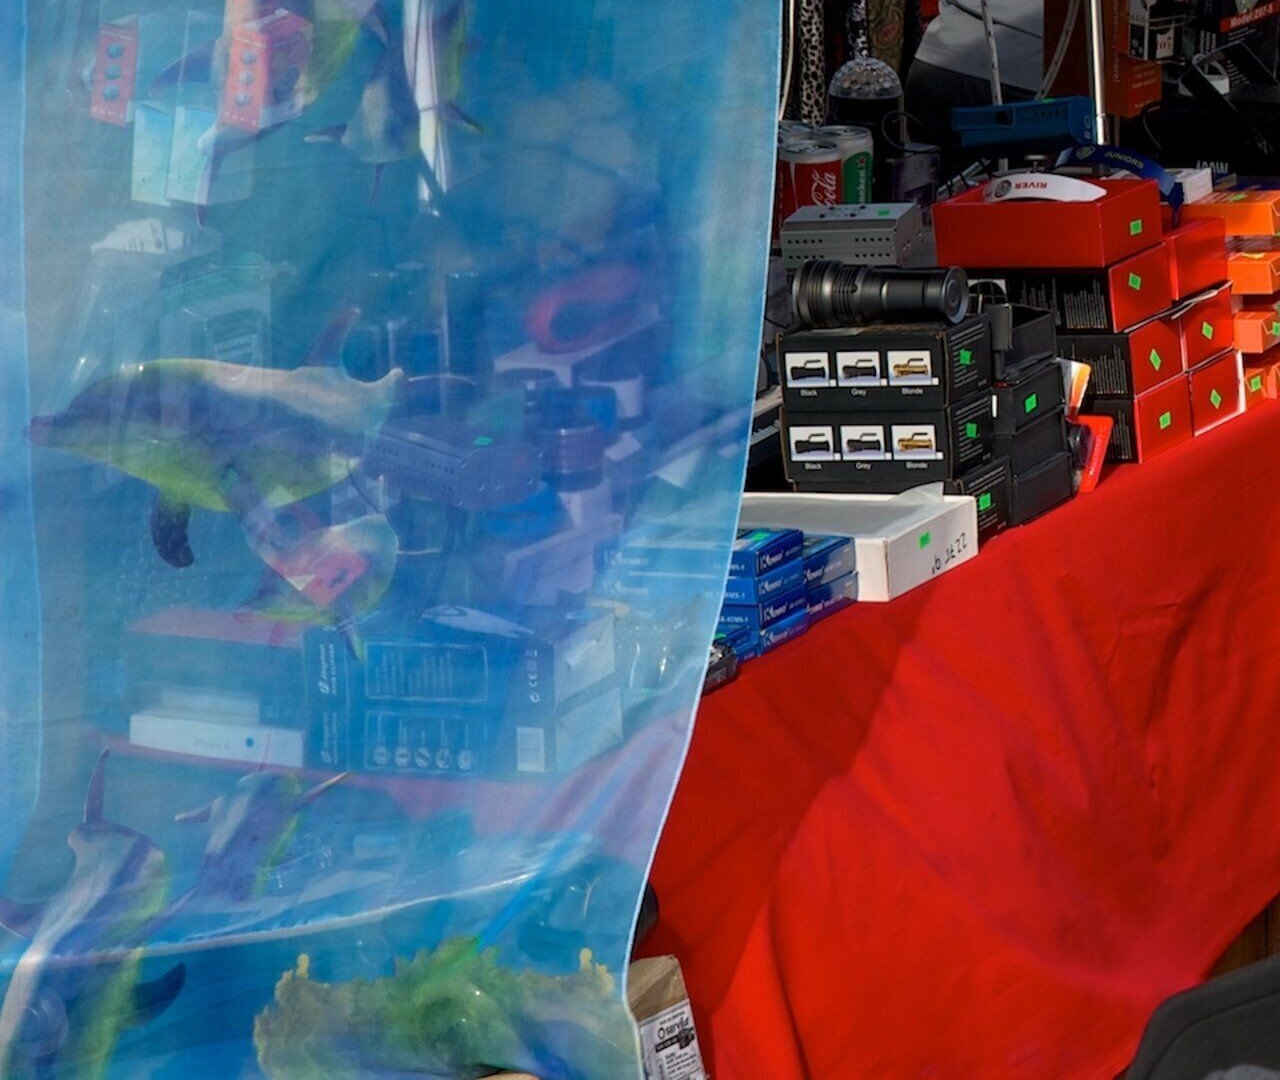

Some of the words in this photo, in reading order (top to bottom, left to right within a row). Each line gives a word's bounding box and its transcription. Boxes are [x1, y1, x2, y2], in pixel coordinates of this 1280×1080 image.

[1104, 150, 1145, 170] JUNIORS
[1014, 181, 1048, 190] RIVER
[800, 388, 818, 397] Black
[851, 388, 867, 397] Grey
[901, 387, 923, 395] Blonde
[804, 462, 822, 471] Black
[856, 462, 872, 471] Grey
[906, 461, 928, 469] Blonde
